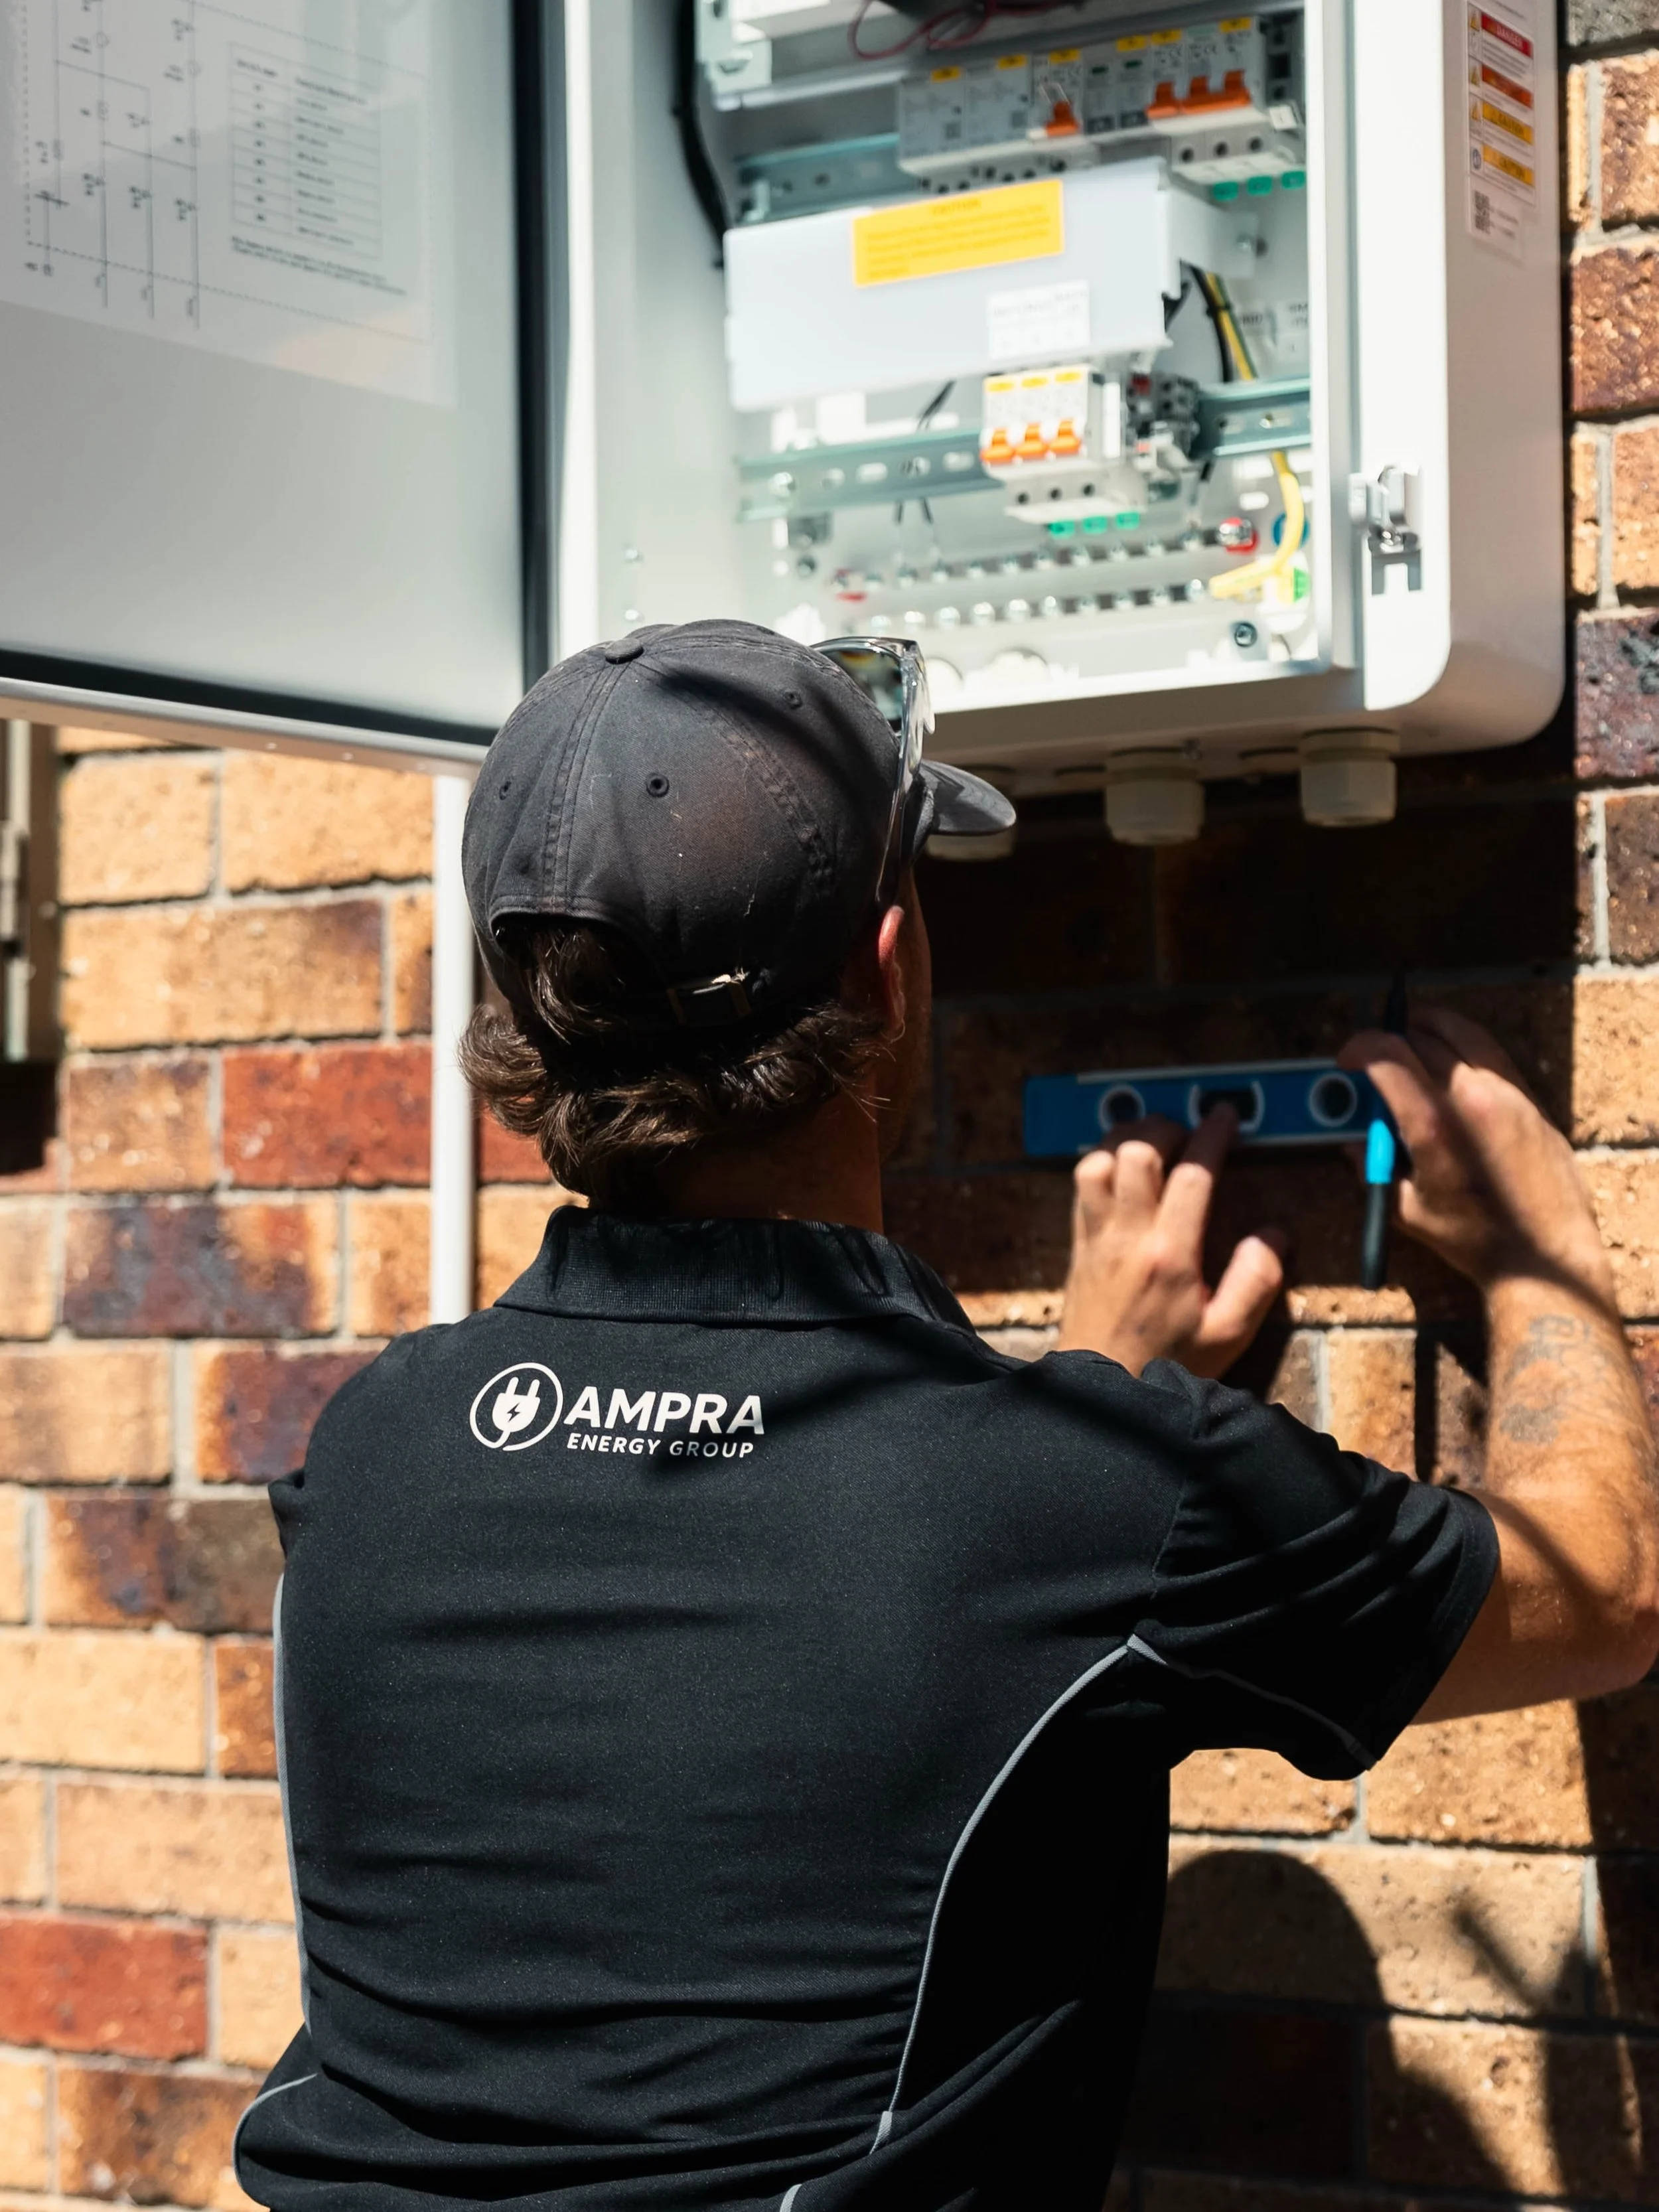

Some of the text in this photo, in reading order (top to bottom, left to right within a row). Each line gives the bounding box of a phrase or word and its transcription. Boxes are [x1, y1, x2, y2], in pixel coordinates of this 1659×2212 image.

[563, 1386, 764, 1435] AMPRA
[566, 1432, 754, 1458] ENERGY GROUP
